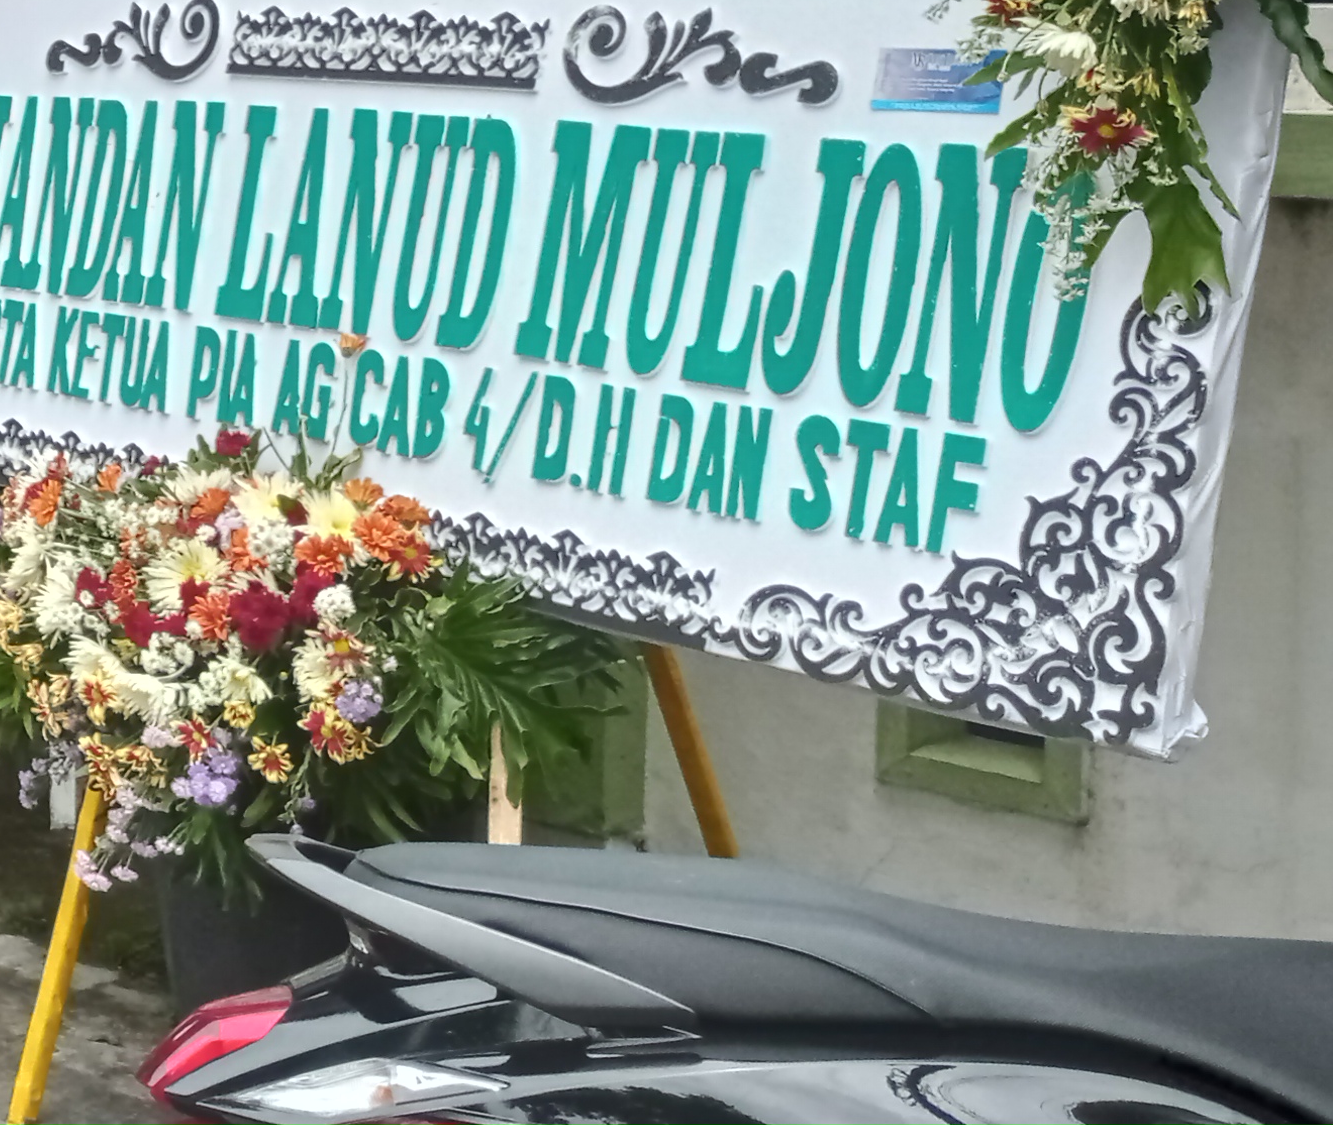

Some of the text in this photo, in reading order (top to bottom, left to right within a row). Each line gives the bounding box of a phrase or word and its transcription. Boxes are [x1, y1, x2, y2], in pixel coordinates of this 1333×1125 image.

[214, 104, 517, 381] LANUD
[513, 117, 1095, 433] MULJONO
[47, 305, 170, 413] KETUA
[186, 325, 257, 428] PIA
[270, 340, 335, 441] AG
[347, 347, 451, 461] CAB
[646, 393, 773, 523] DAN
[788, 413, 988, 555] STAF
